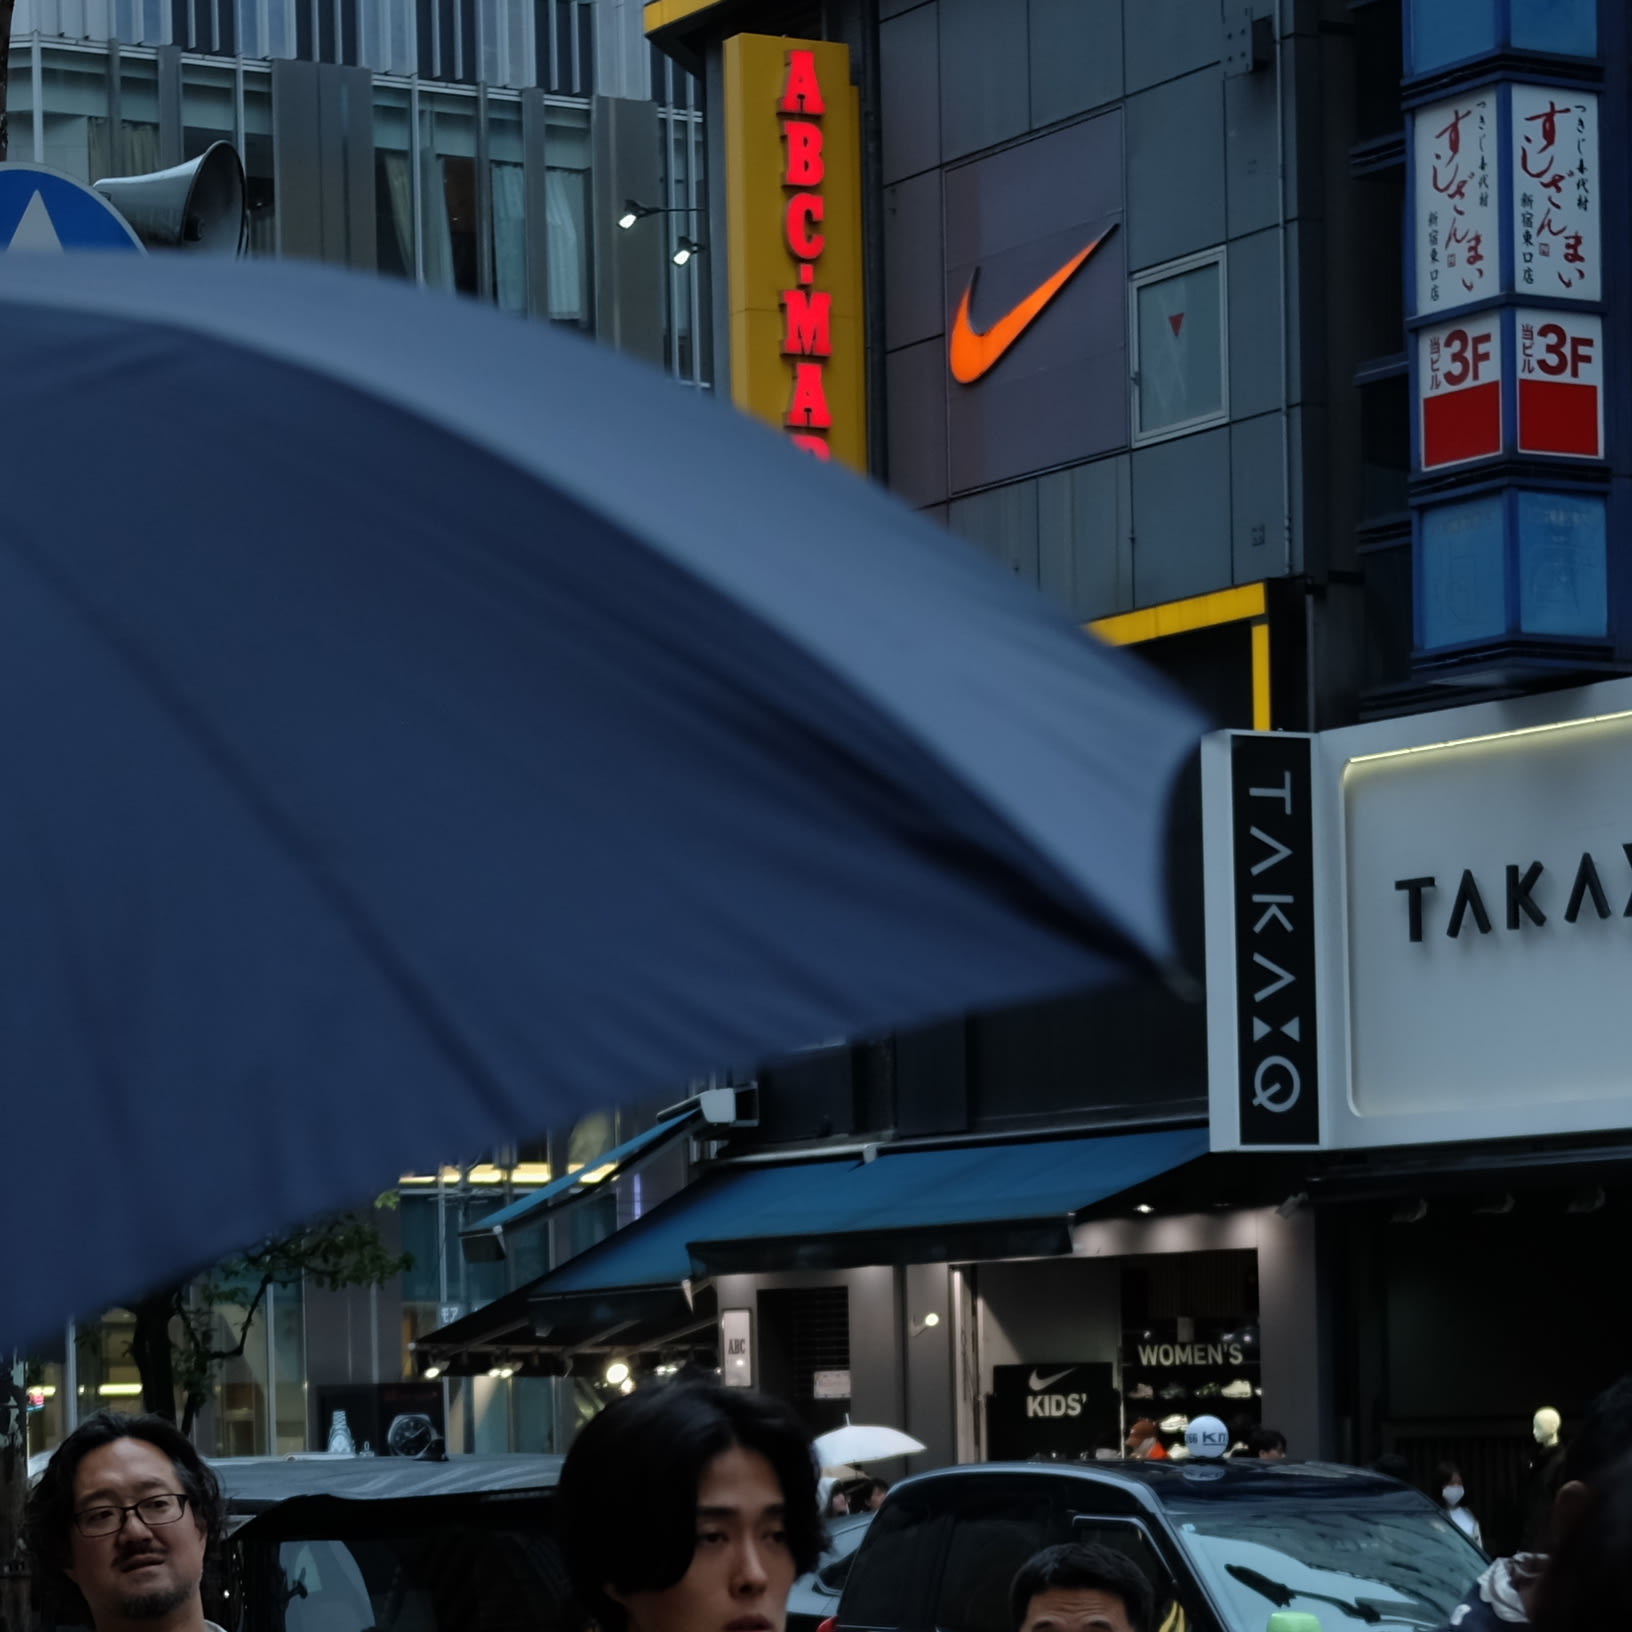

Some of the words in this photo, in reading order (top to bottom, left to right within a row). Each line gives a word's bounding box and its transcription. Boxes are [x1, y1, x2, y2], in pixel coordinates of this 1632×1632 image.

[1521, 193, 1534, 284] 新宿東口店
[1443, 329, 1492, 386] 3F
[1521, 323, 1534, 374] 当ビル
[1537, 324, 1594, 378] 3F
[1137, 1344, 1244, 1367] WOMEN'S
[1026, 1393, 1087, 1418] KIDS'
